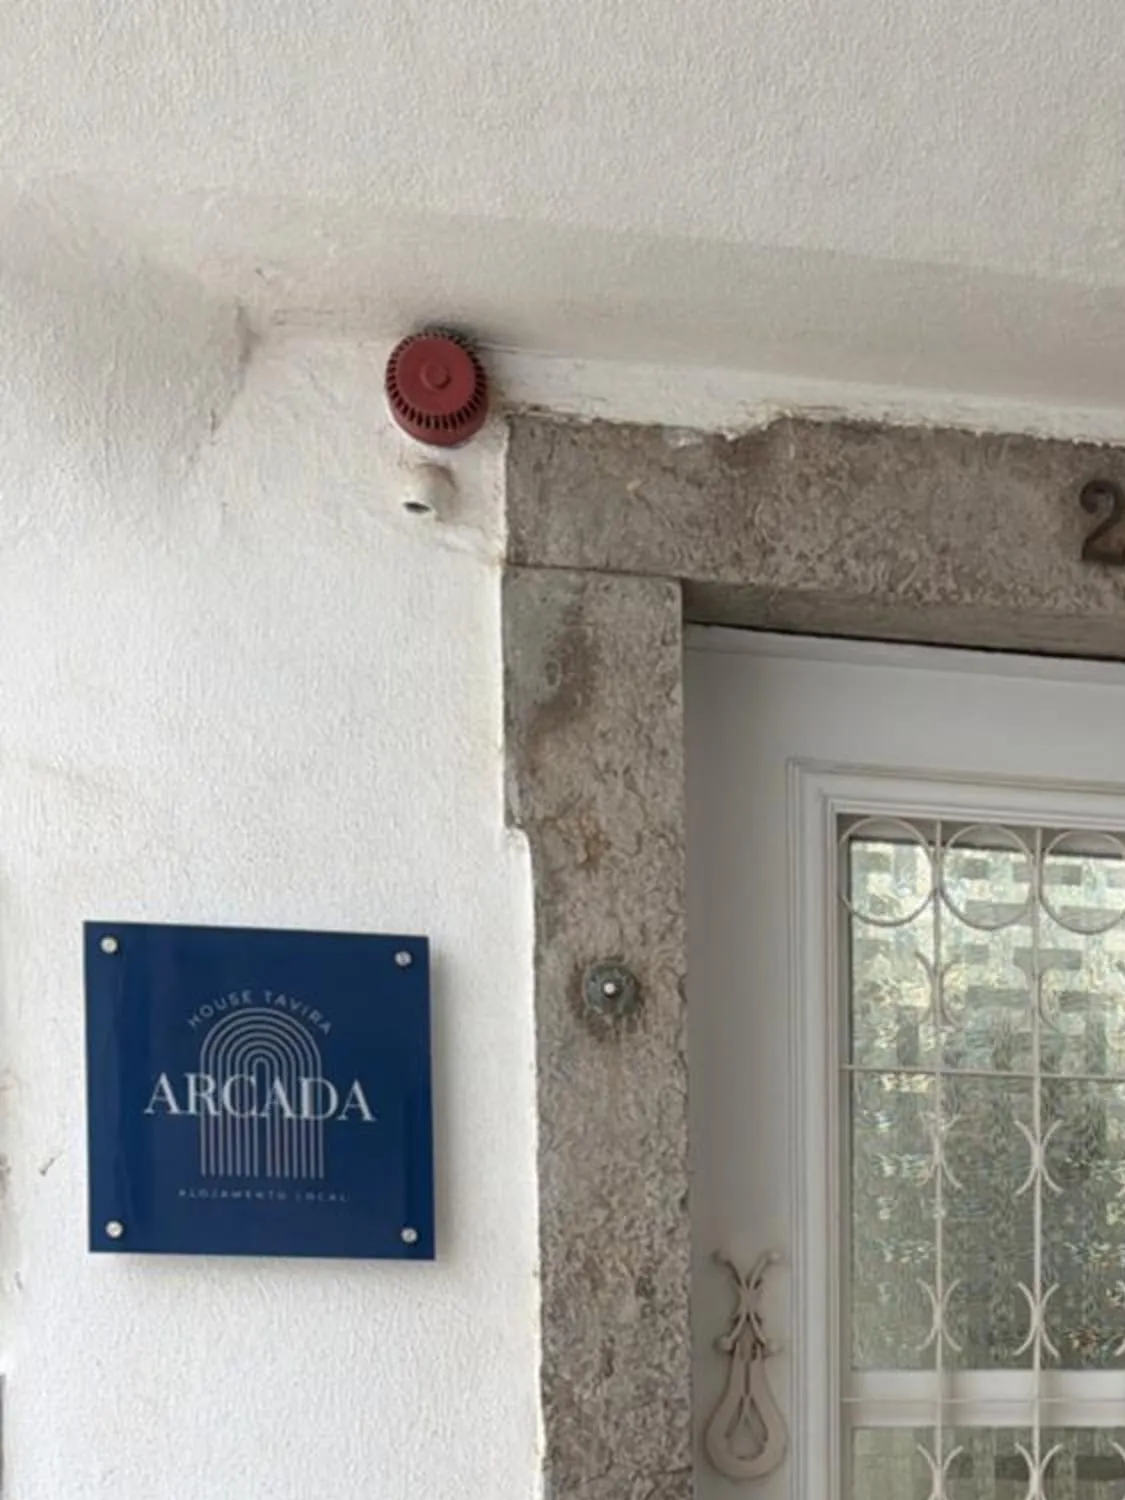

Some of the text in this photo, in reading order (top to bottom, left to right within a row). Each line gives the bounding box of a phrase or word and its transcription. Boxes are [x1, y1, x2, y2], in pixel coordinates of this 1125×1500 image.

[187, 990, 333, 1035] HOUSE TAVIRA
[144, 1072, 377, 1122] ARCADA
